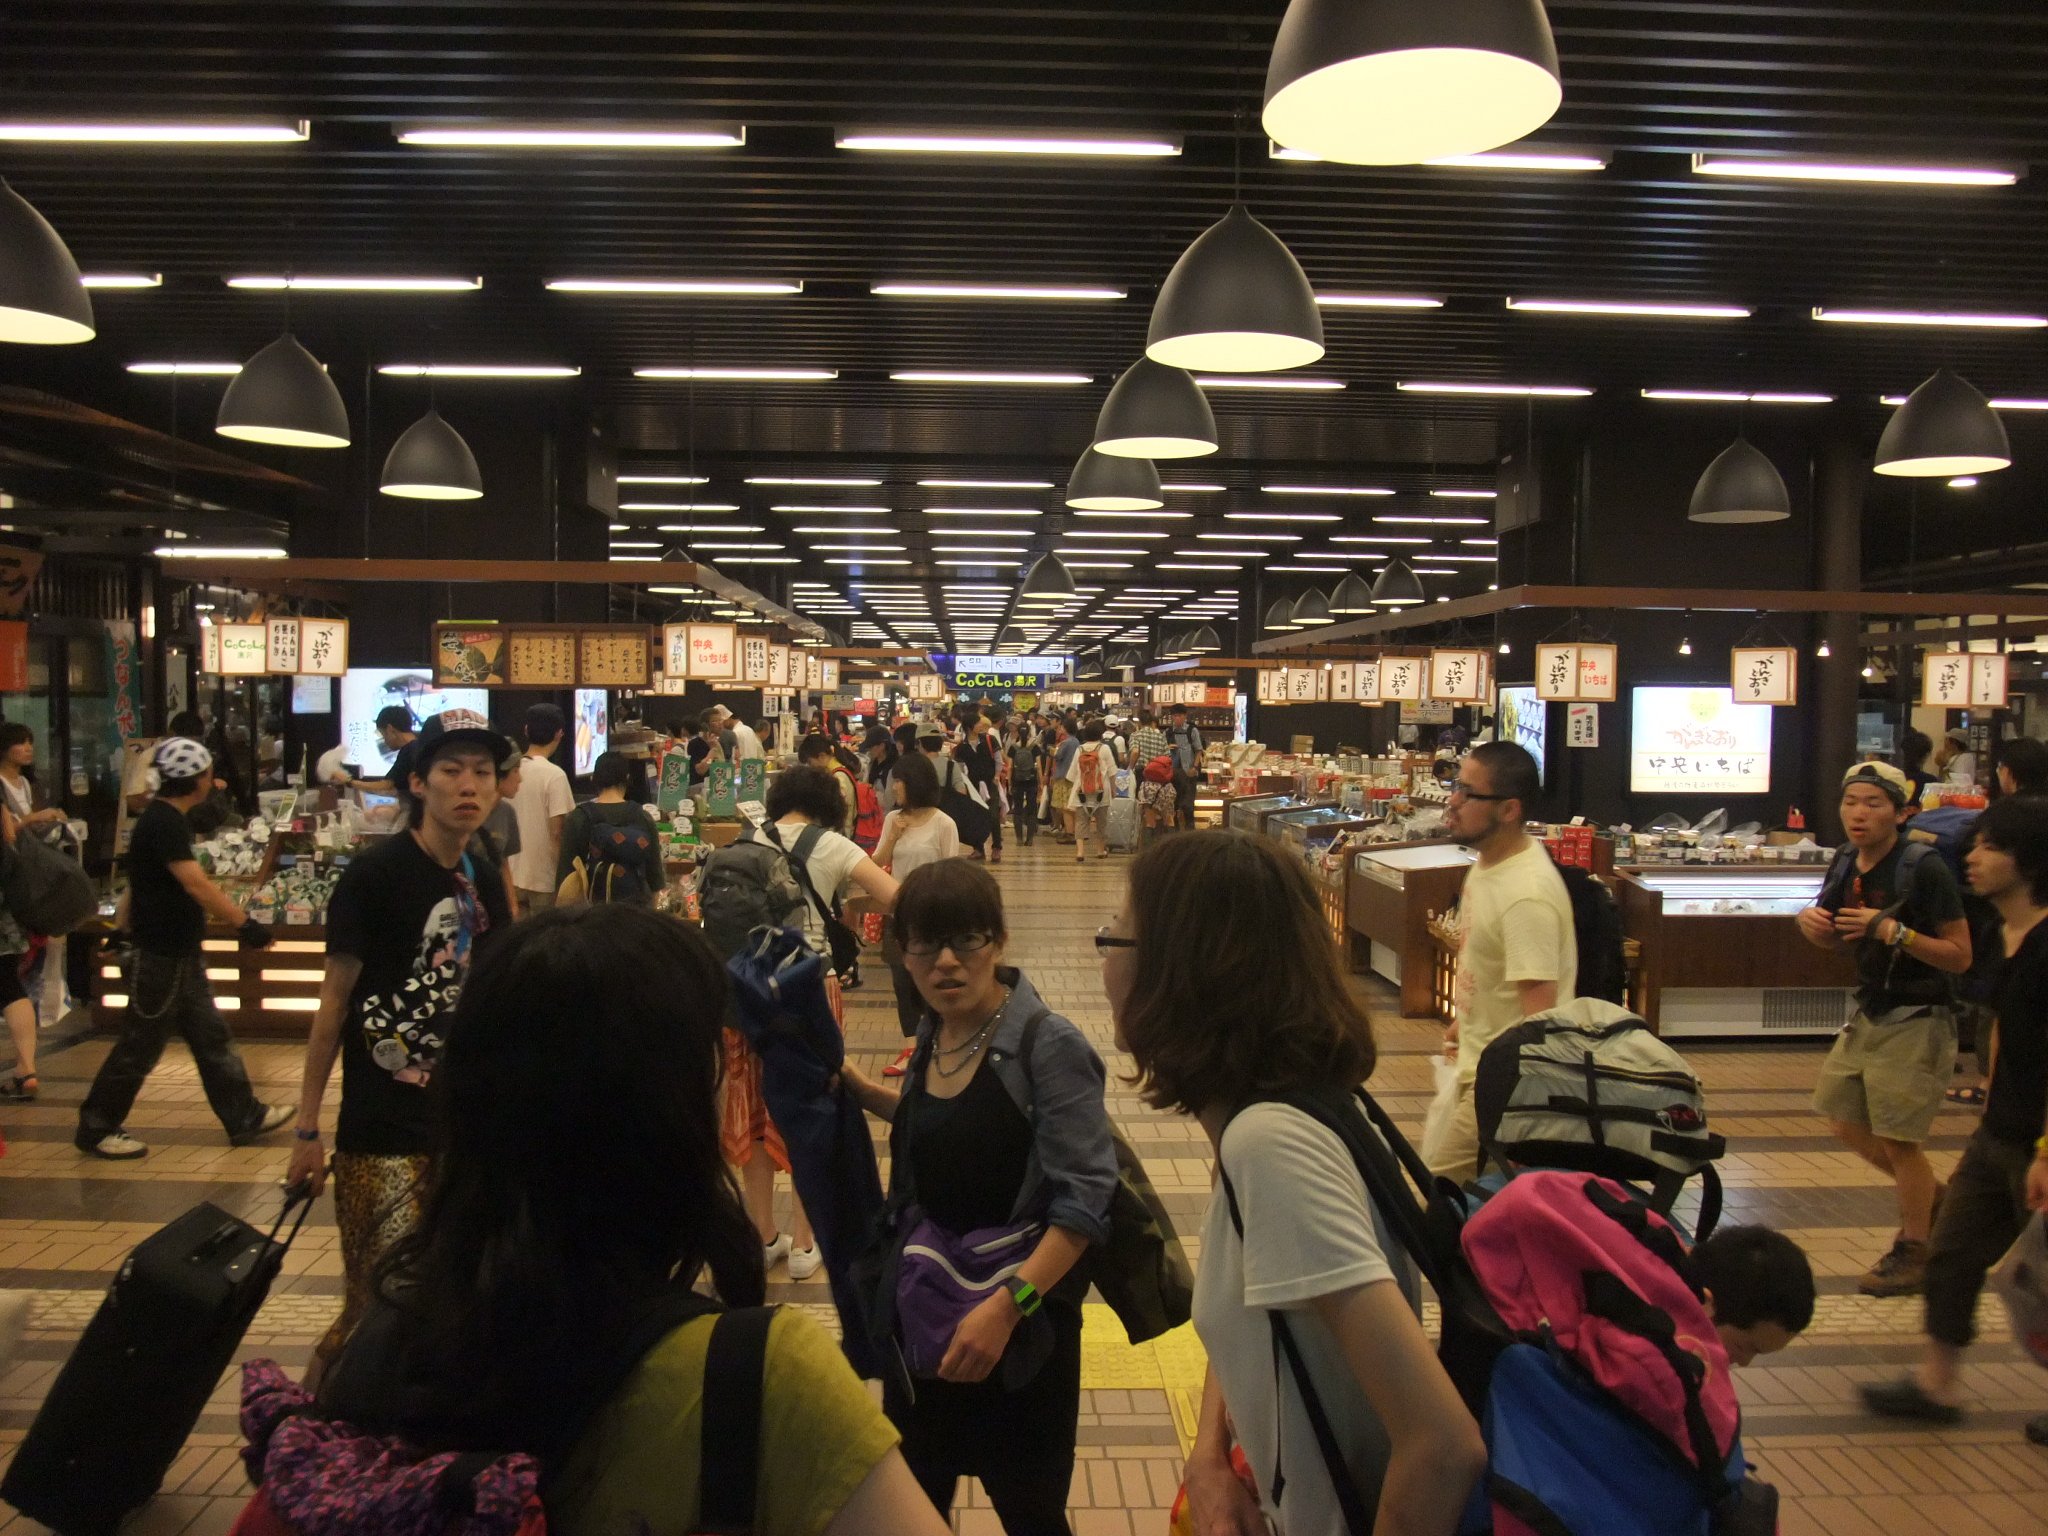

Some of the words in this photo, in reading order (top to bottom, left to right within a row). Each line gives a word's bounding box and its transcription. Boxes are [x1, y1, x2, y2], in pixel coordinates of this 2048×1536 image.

[693, 639, 713, 650] 中央
[698, 653, 728, 664] いちば
[955, 673, 1012, 688] CoCoLo
[1013, 675, 1037, 687] 湯沢
[1584, 674, 1608, 686] いちば
[1649, 755, 1755, 775] 中央いちば
